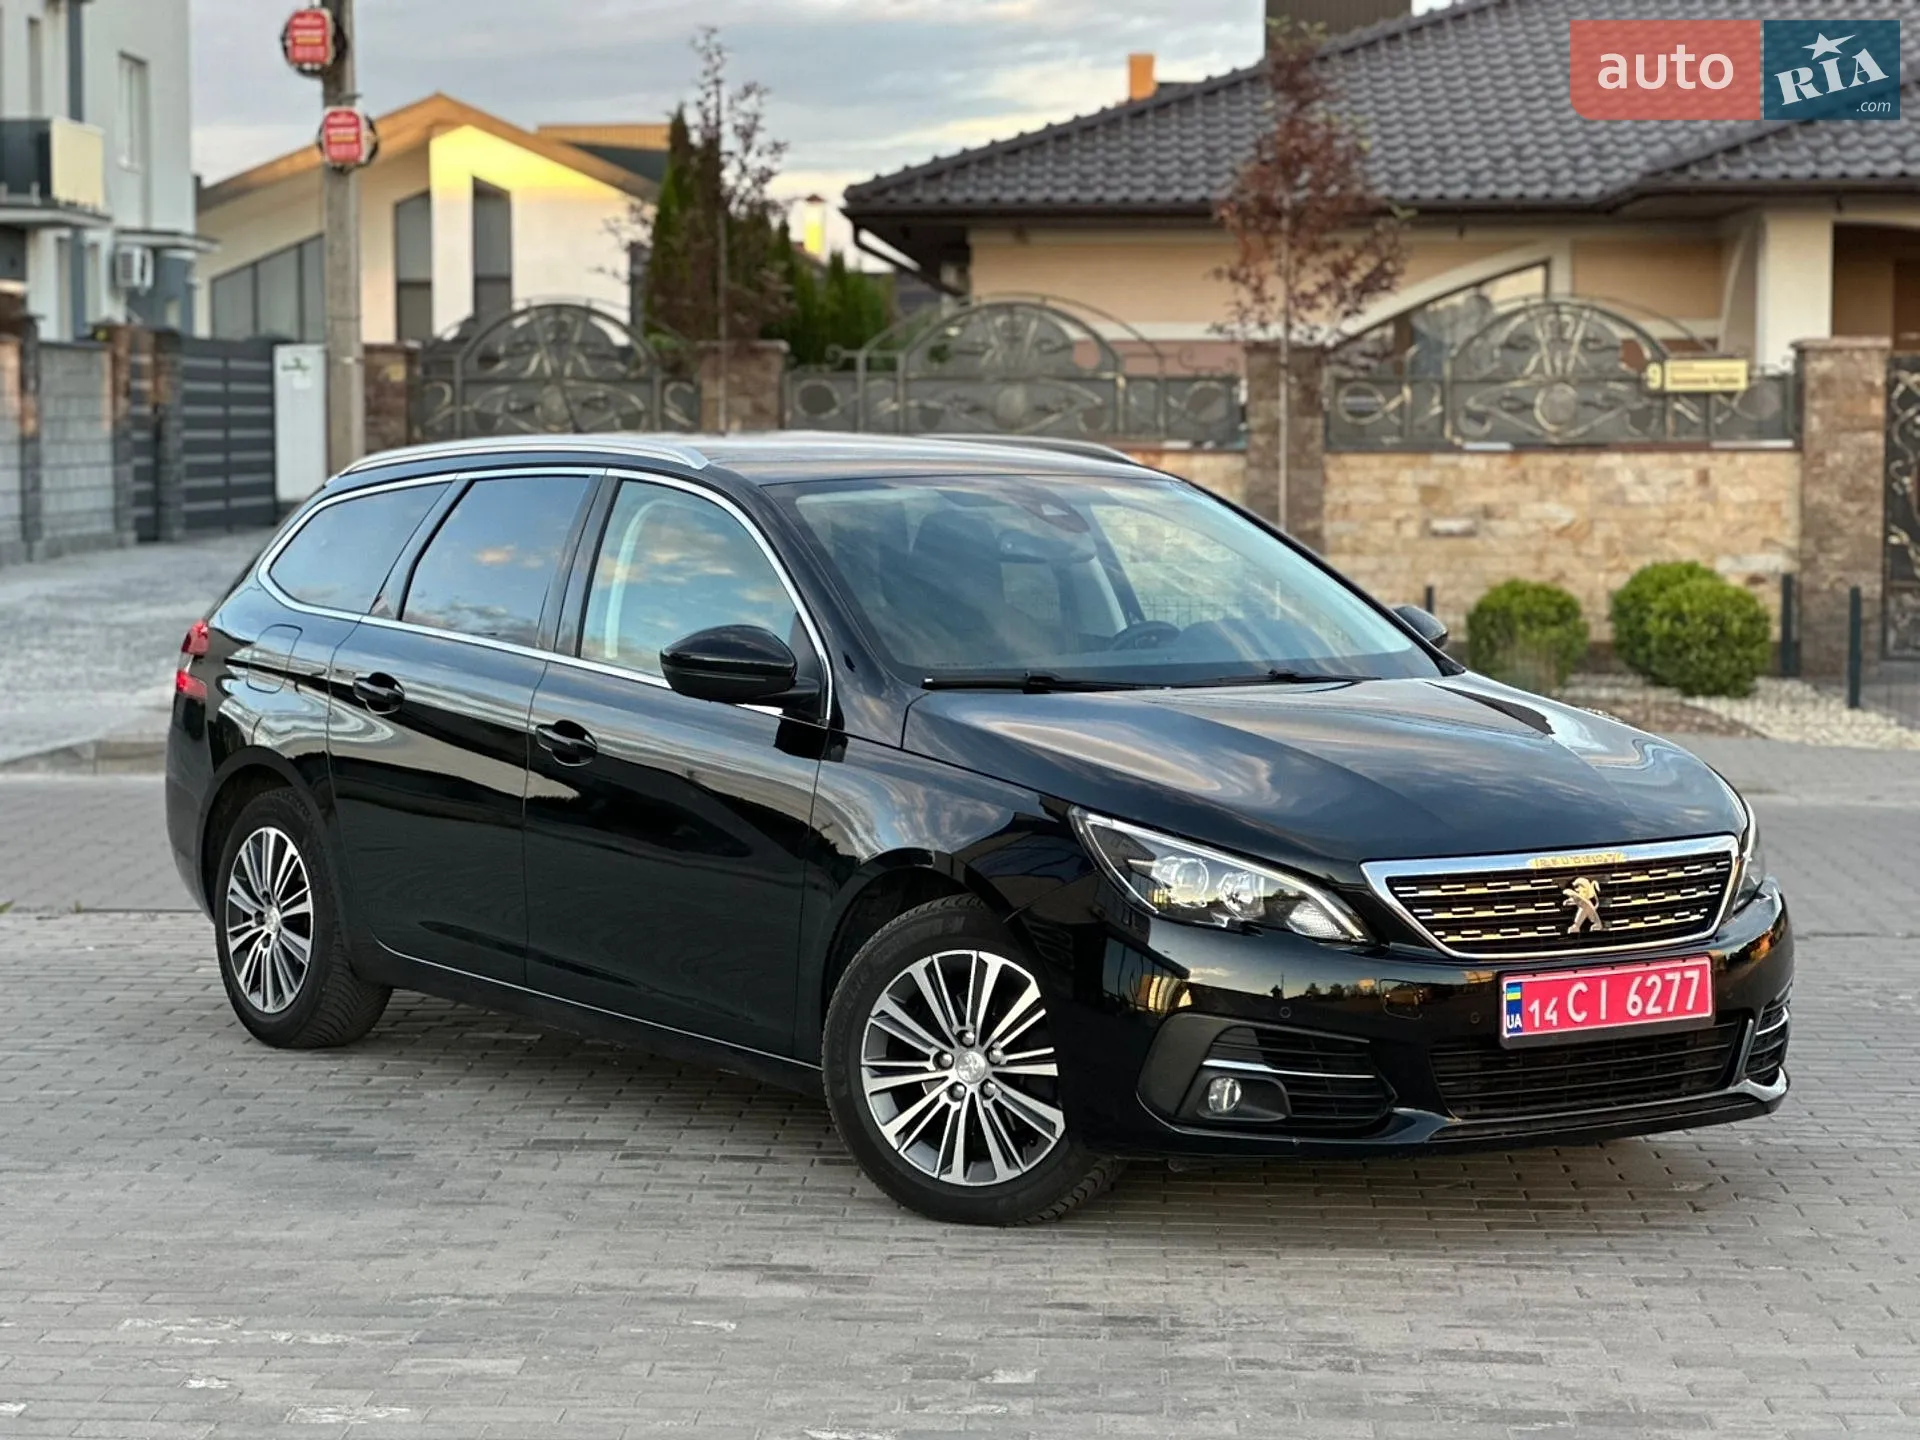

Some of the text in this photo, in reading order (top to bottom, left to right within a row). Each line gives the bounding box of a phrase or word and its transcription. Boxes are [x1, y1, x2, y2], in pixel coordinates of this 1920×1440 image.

[1528, 996, 1558, 1028] 14
[1626, 970, 1700, 1017] 6277
[1506, 1014, 1522, 1029] UA
